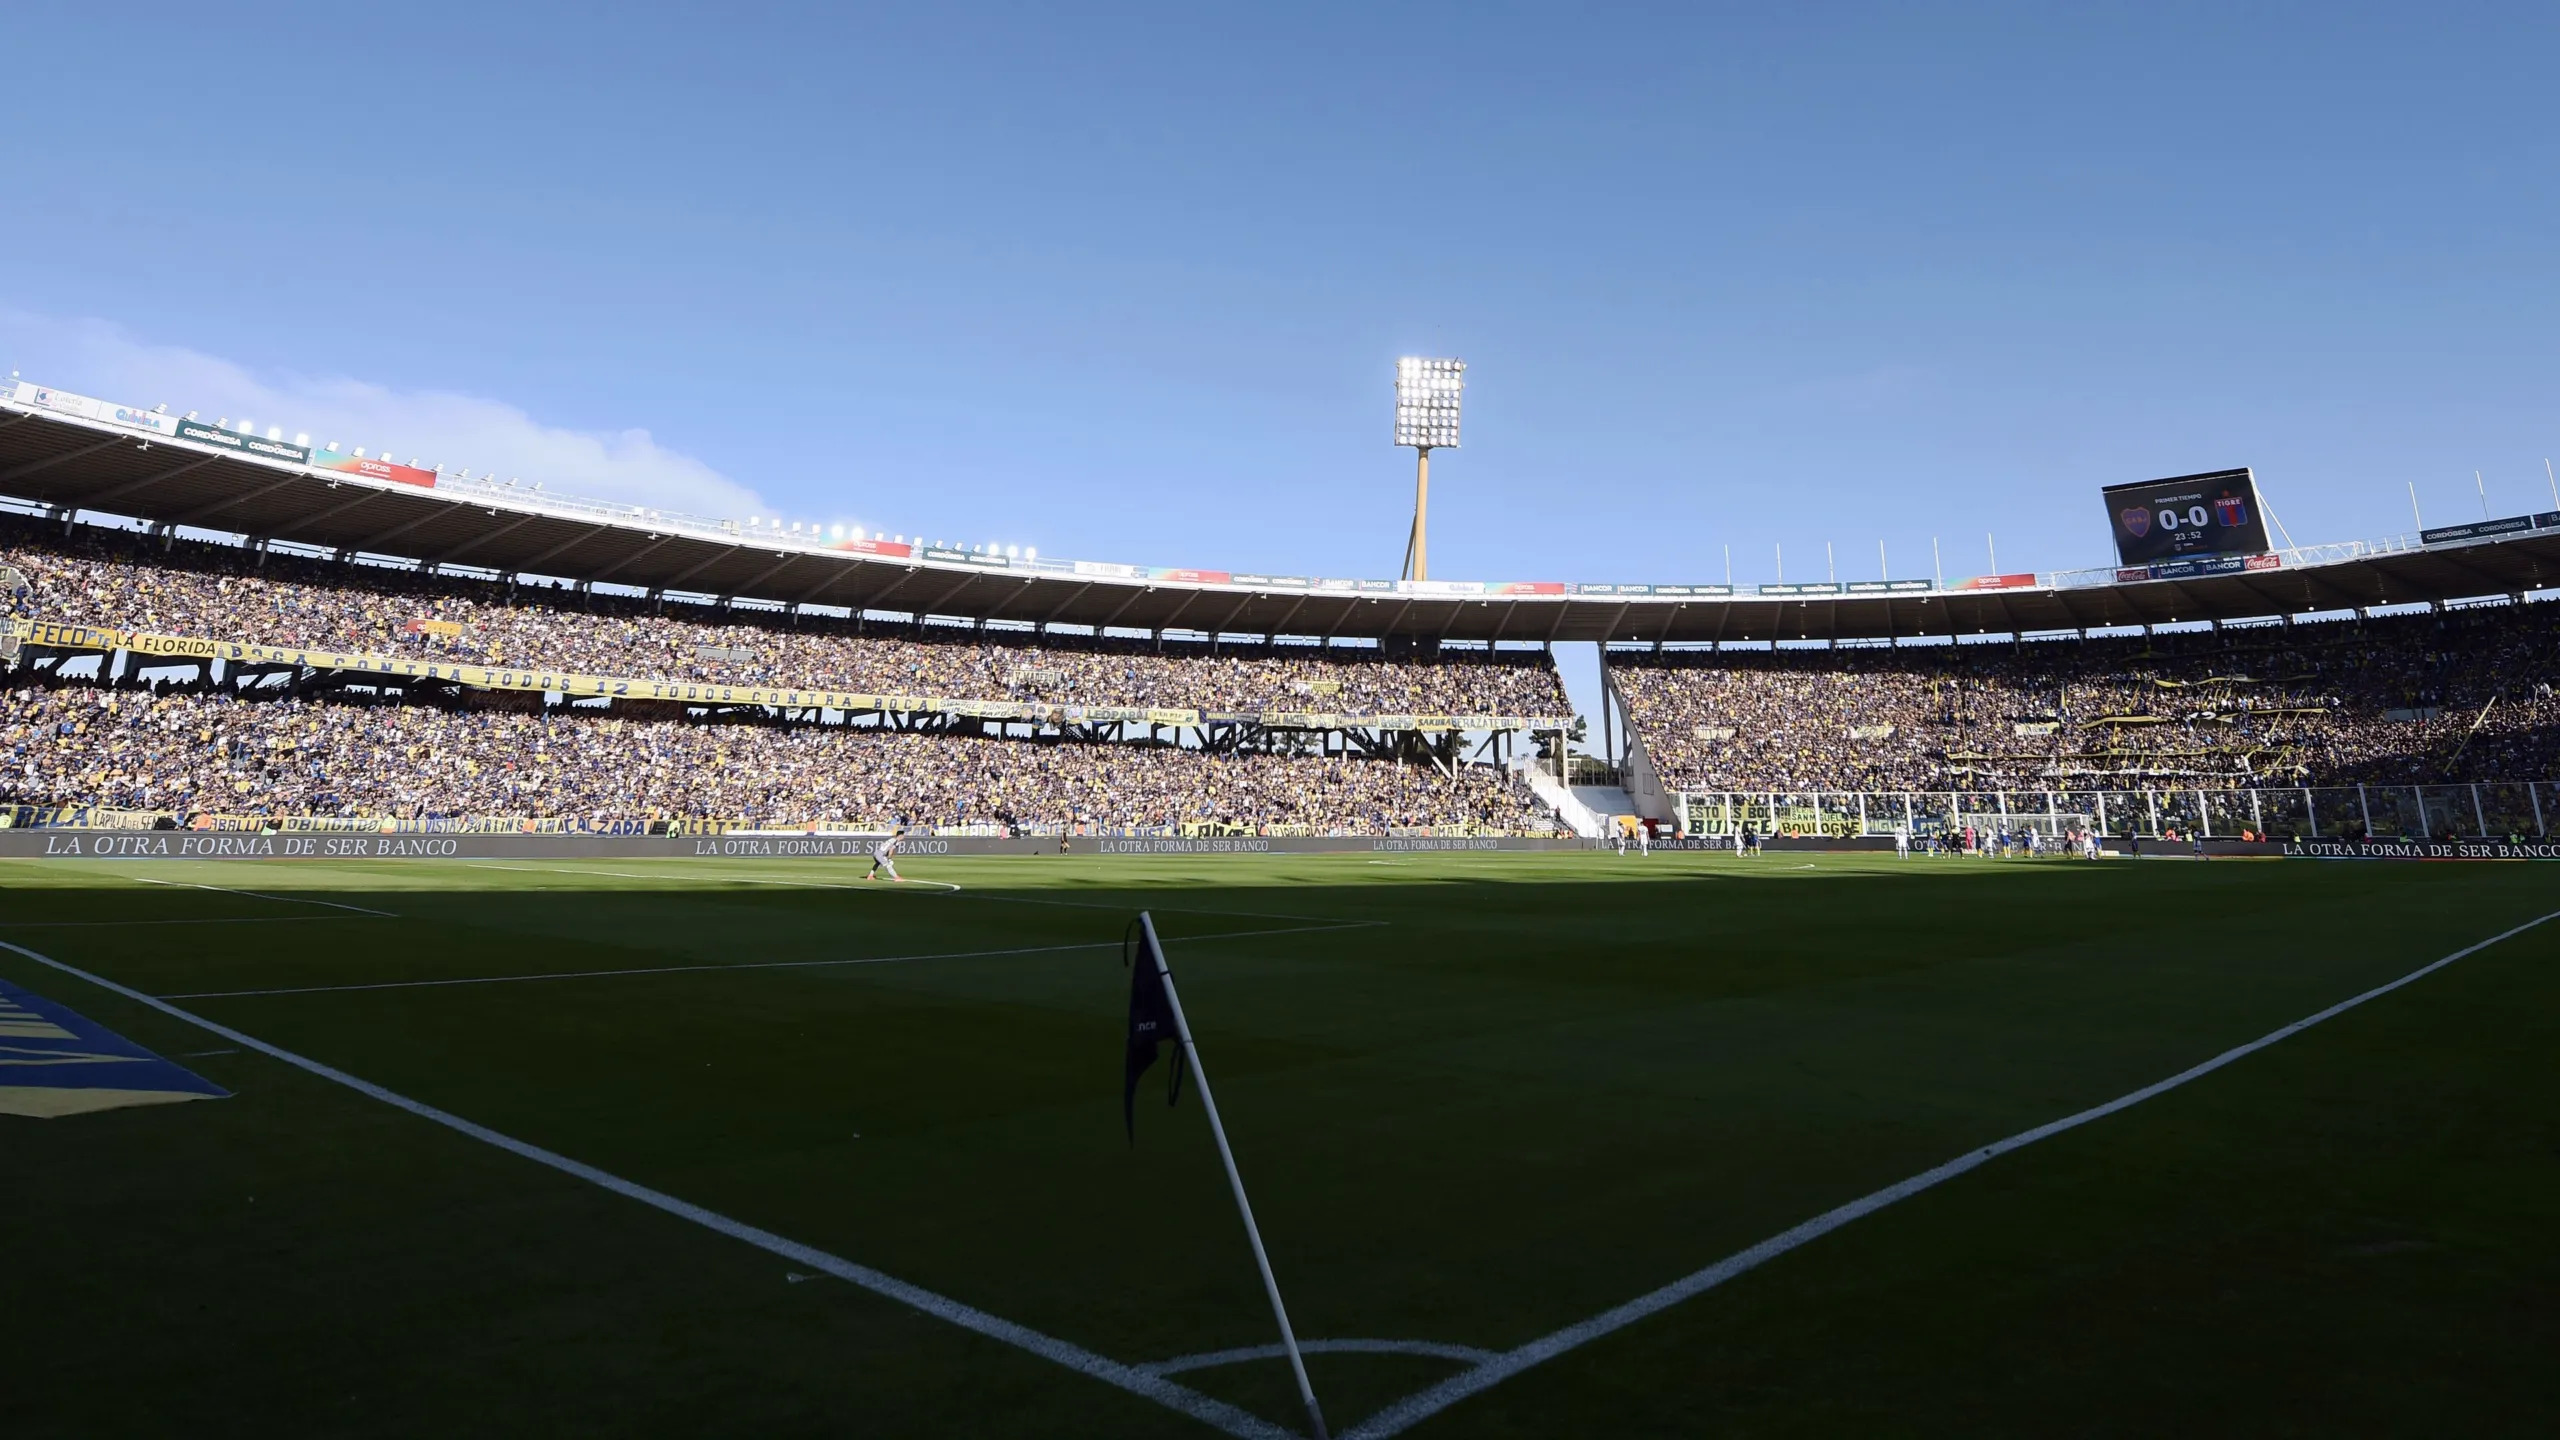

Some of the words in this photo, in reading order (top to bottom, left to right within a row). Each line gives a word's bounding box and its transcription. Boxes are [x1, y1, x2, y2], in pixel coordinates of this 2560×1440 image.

[2216, 499, 2241, 507] TIGRE
[2161, 565, 2195, 575] BANCOR
[2206, 562, 2241, 571] BANCOR
[144, 638, 216, 655] FLORIDA
[485, 672, 570, 691] TODOS
[597, 681, 629, 696] 12
[653, 685, 733, 701] TODOS
[752, 692, 852, 707] CONTRA
[874, 698, 928, 711] BOCA
[1688, 806, 1719, 819] ESTO
[564, 816, 645, 835] CALZADA
[45, 836, 82, 855] LA
[94, 836, 169, 855] OTRA
[181, 836, 274, 855] FORMA
[283, 836, 317, 855] DE
[325, 836, 368, 855] SER
[375, 836, 457, 855] BANCO
[695, 841, 718, 855] LA
[725, 841, 771, 855] OTRA
[777, 841, 835, 855] FORMA
[841, 841, 860, 855] DE
[899, 841, 948, 855] BANCO
[1100, 840, 1115, 853] LA
[1119, 840, 1150, 853] OTRA
[1154, 840, 1193, 853] FORMA
[1196, 840, 1209, 853] DE
[1212, 840, 1231, 853] SER
[1234, 840, 1269, 853] BANCO
[1373, 840, 1385, 851] LA
[1386, 840, 1409, 851] OTRA
[1410, 840, 1439, 851] FORMA
[1441, 840, 1451, 851] DE
[1452, 840, 1467, 851] SER
[1469, 840, 1498, 851] BANCO
[1602, 839, 1615, 849] LA
[1649, 839, 1685, 849] FORMA
[1687, 839, 1700, 849] DE
[1703, 839, 1722, 849] SER
[2282, 844, 2305, 857] LA
[2309, 844, 2356, 857] OTRA
[2361, 844, 2425, 857] FORMA
[2430, 844, 2454, 857] DE
[2459, 844, 2493, 857] SER
[2497, 844, 2560, 857] BANCO
